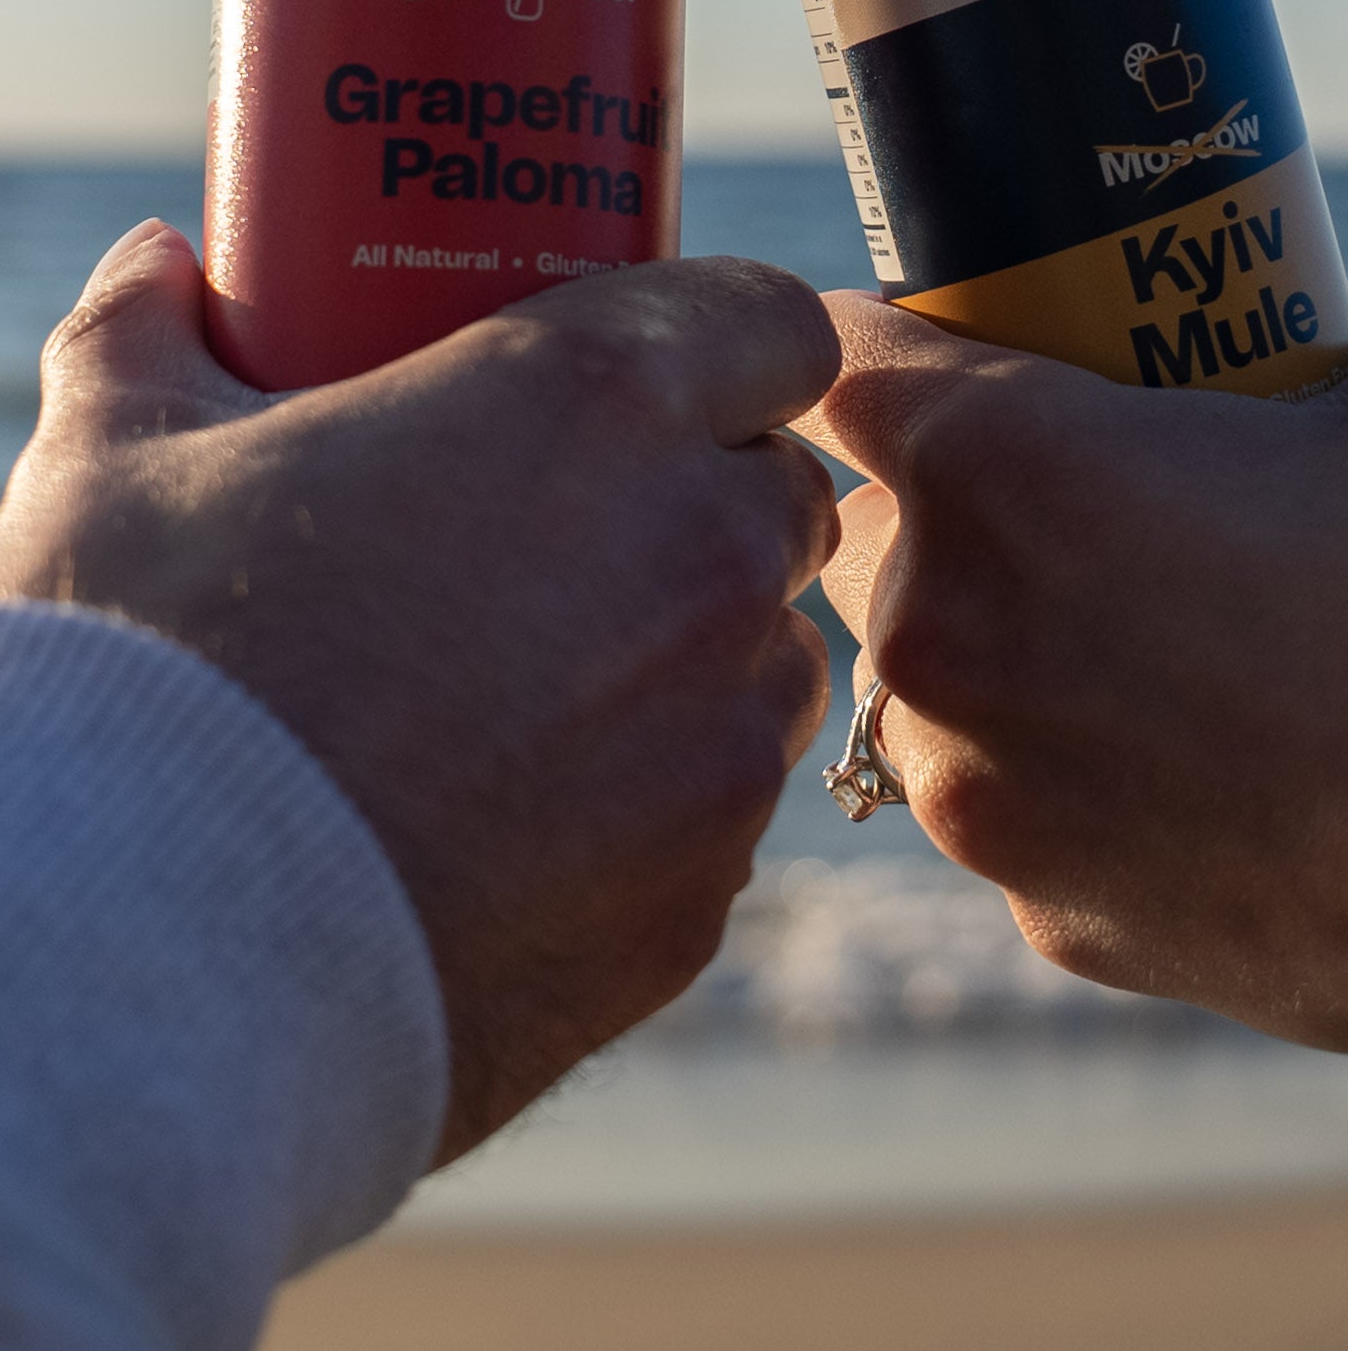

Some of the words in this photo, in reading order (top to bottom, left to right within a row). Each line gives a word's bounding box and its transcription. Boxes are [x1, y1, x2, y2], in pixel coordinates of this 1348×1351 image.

[324, 62, 671, 153] Grapefruit
[382, 137, 643, 217] Paloma
[1098, 114, 1260, 188] Moscow
[352, 245, 387, 267] All
[394, 245, 500, 271] Natural
[1120, 200, 1284, 306] Kyiv
[1129, 285, 1319, 389] Mule
